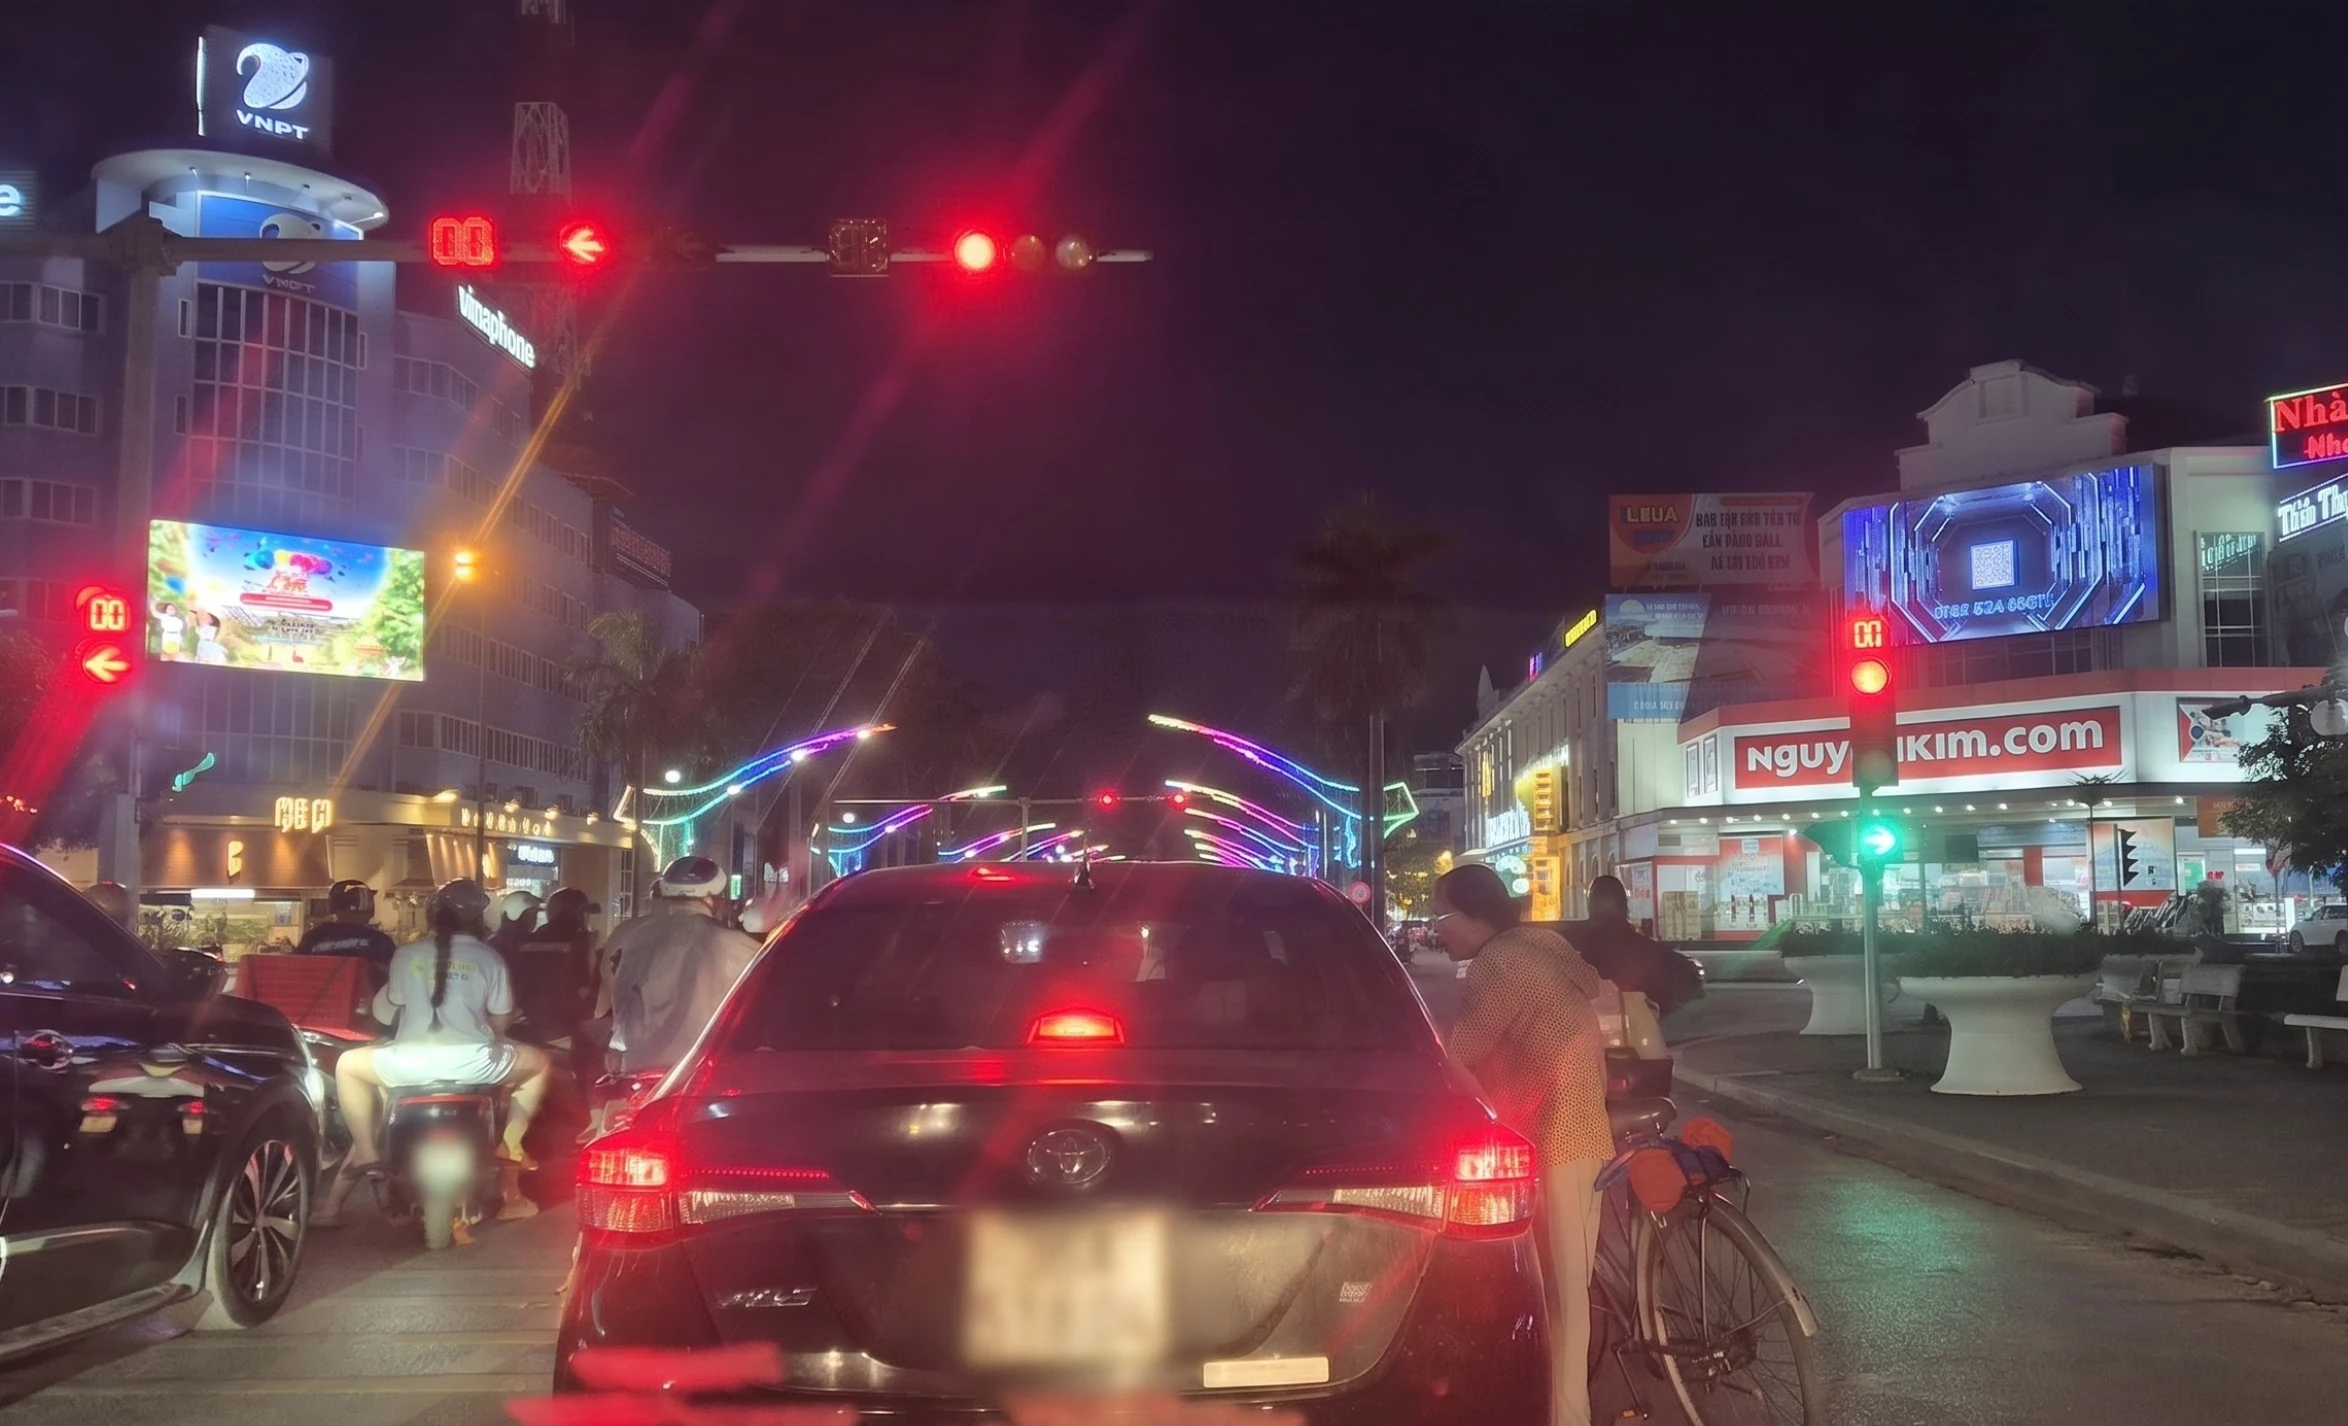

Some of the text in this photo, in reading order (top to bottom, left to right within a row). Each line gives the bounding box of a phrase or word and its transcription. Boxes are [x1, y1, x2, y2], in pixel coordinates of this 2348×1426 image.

[236, 109, 309, 139] VNPT
[433, 216, 494, 265] 00
[458, 284, 535, 368] vinaphone
[90, 599, 125, 630] 00
